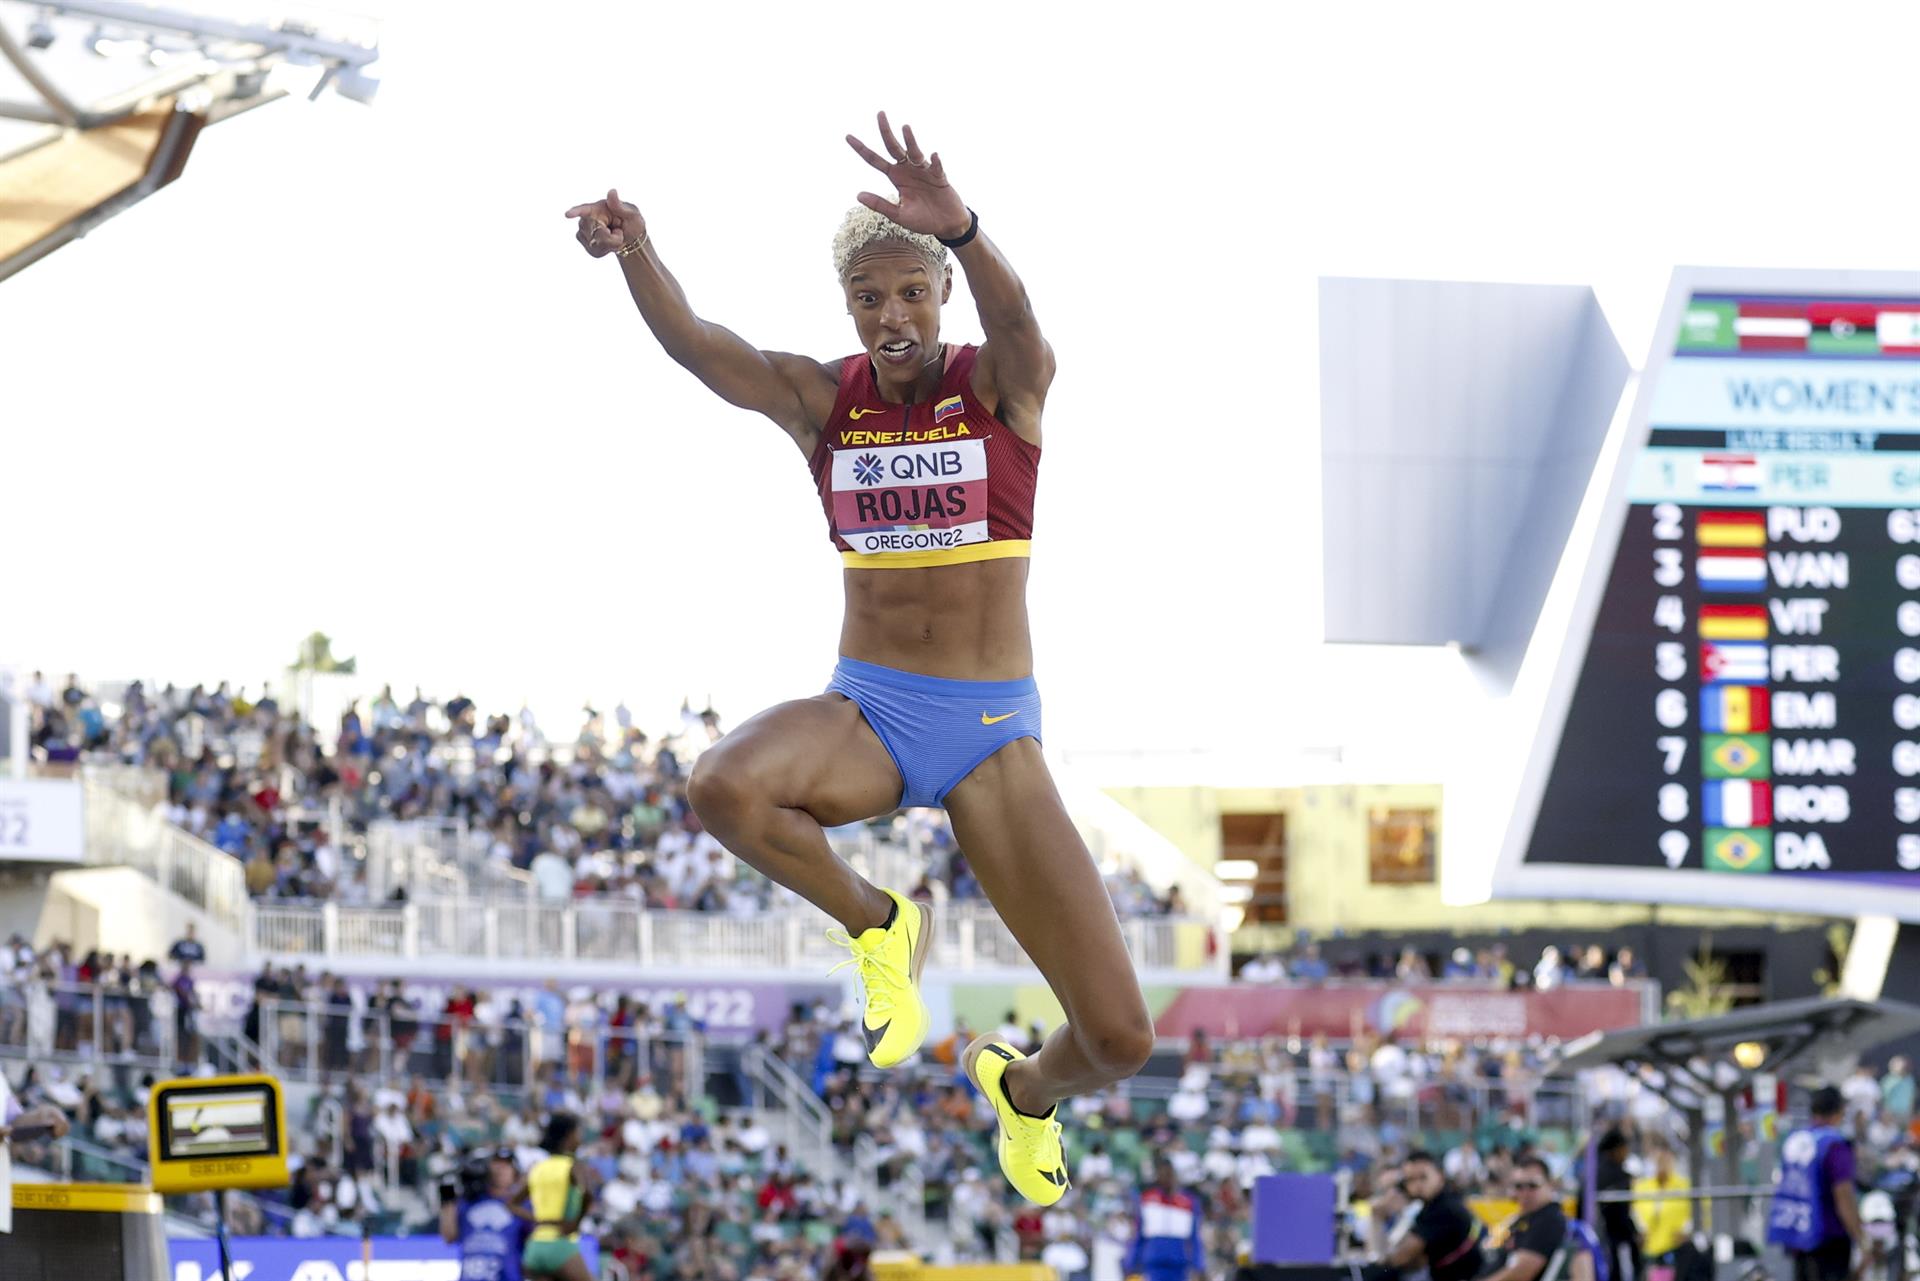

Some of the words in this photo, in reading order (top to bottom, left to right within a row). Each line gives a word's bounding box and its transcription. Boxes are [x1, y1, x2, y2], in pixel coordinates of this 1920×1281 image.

[840, 422, 971, 445] VENEZUELA
[891, 451, 963, 479] QNB
[855, 485, 967, 522] ROJAS
[1653, 503, 1683, 540] 2
[1767, 507, 1841, 543] PUD
[865, 529, 963, 550] OREGON22
[1653, 547, 1684, 586] 3
[1768, 552, 1849, 589] VAN
[1653, 595, 1685, 633] 4
[1768, 598, 1829, 635] VIT
[1655, 641, 1687, 681] 5
[1770, 645, 1840, 682] PER
[1655, 688, 1688, 728] 6
[1771, 691, 1837, 729] EMI
[1656, 735, 1688, 775] 7
[1772, 738, 1856, 776] MAR
[1657, 782, 1690, 822] 8
[1773, 785, 1850, 823] ROB
[1658, 829, 1690, 869] 9
[1773, 831, 1832, 870] DA
[189, 1162, 251, 1178] SEIKO
